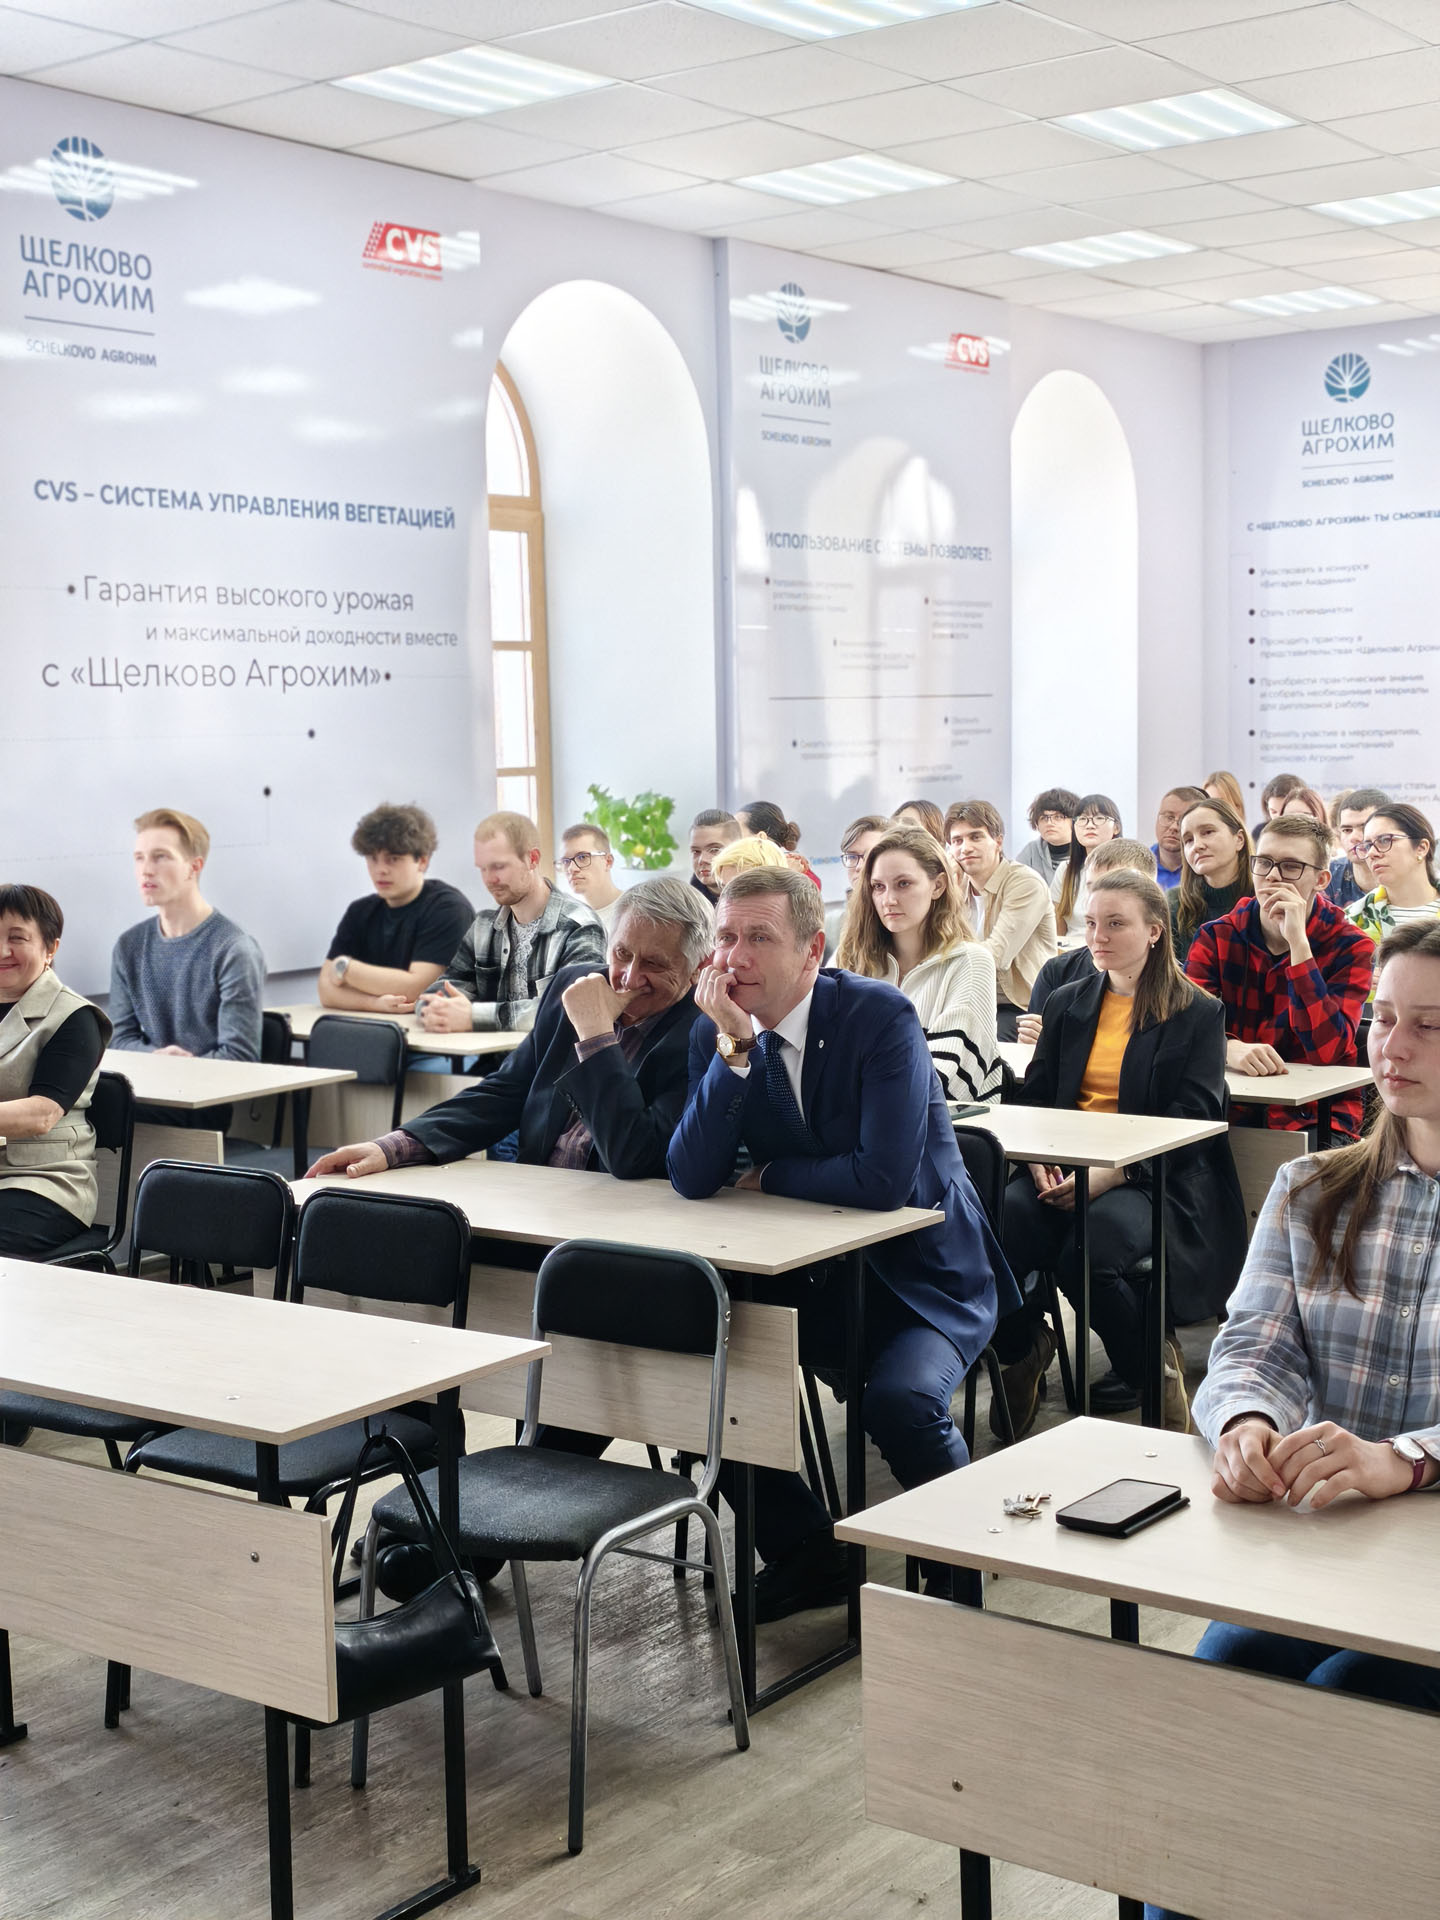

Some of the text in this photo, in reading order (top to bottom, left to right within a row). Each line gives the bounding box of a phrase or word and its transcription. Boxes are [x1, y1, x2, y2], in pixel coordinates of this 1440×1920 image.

[20, 234, 152, 281] ЩЕЛКОВО
[386, 228, 440, 267] CVS
[23, 269, 154, 314] АГРОХИМ
[26, 338, 157, 367] SCHELKOVO AGROHIM
[957, 337, 989, 365] CVS
[760, 381, 832, 409] АГРОХИМ
[1302, 412, 1395, 437] ЩЕЛКОВО
[1302, 432, 1395, 456] АГРОХИМ
[1302, 473, 1394, 488] SCHELKOVO AGROHIM
[34, 479, 78, 502] CVS
[100, 484, 203, 511] СИСТЕМА
[208, 492, 340, 521] УПРАВЛЕНИЯ
[344, 502, 455, 530] ВЕГЕТАЦИЕЙ
[1374, 513, 1389, 522] ТЫ
[765, 532, 873, 555] ИСПОЛЬЗОВАНИЕ
[873, 539, 928, 557] СЕМЫ
[84, 576, 414, 615] Гарантия высокого урожая
[146, 626, 458, 646] и максимальной доходности вместе
[42, 656, 381, 694] с «Щелково Агрохим»
